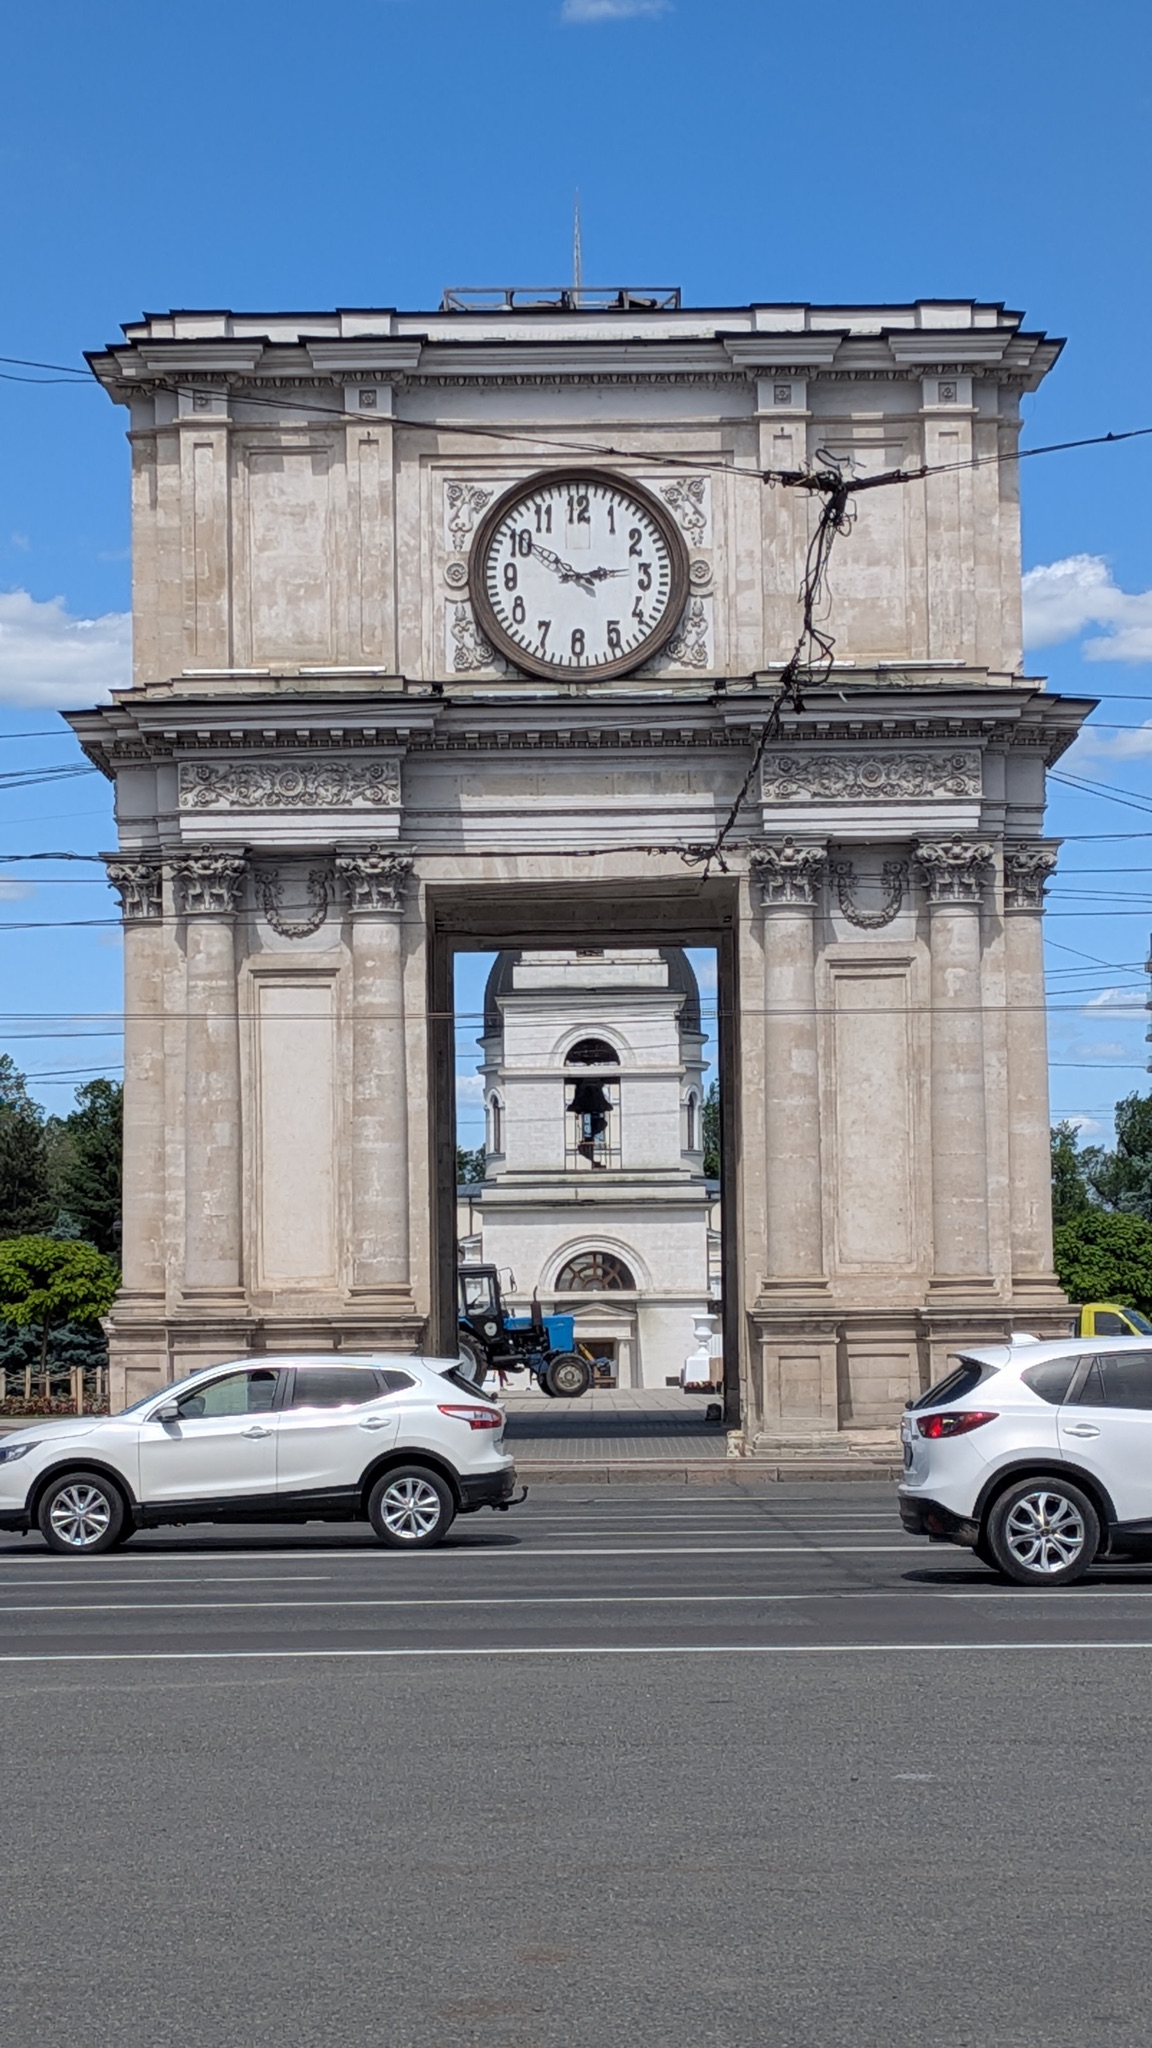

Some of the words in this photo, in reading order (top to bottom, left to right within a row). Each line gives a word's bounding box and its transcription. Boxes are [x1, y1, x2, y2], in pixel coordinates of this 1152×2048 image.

[534, 504, 552, 533] 11
[568, 495, 590, 524] 12
[608, 505, 616, 534] 1
[510, 528, 532, 558] 10
[629, 528, 642, 557] 2
[504, 562, 517, 591] 9
[638, 562, 652, 591] 3
[512, 595, 525, 625] 8
[632, 596, 644, 625] 4
[538, 620, 551, 649] 7
[571, 628, 585, 657] 6
[607, 620, 620, 648] 5
